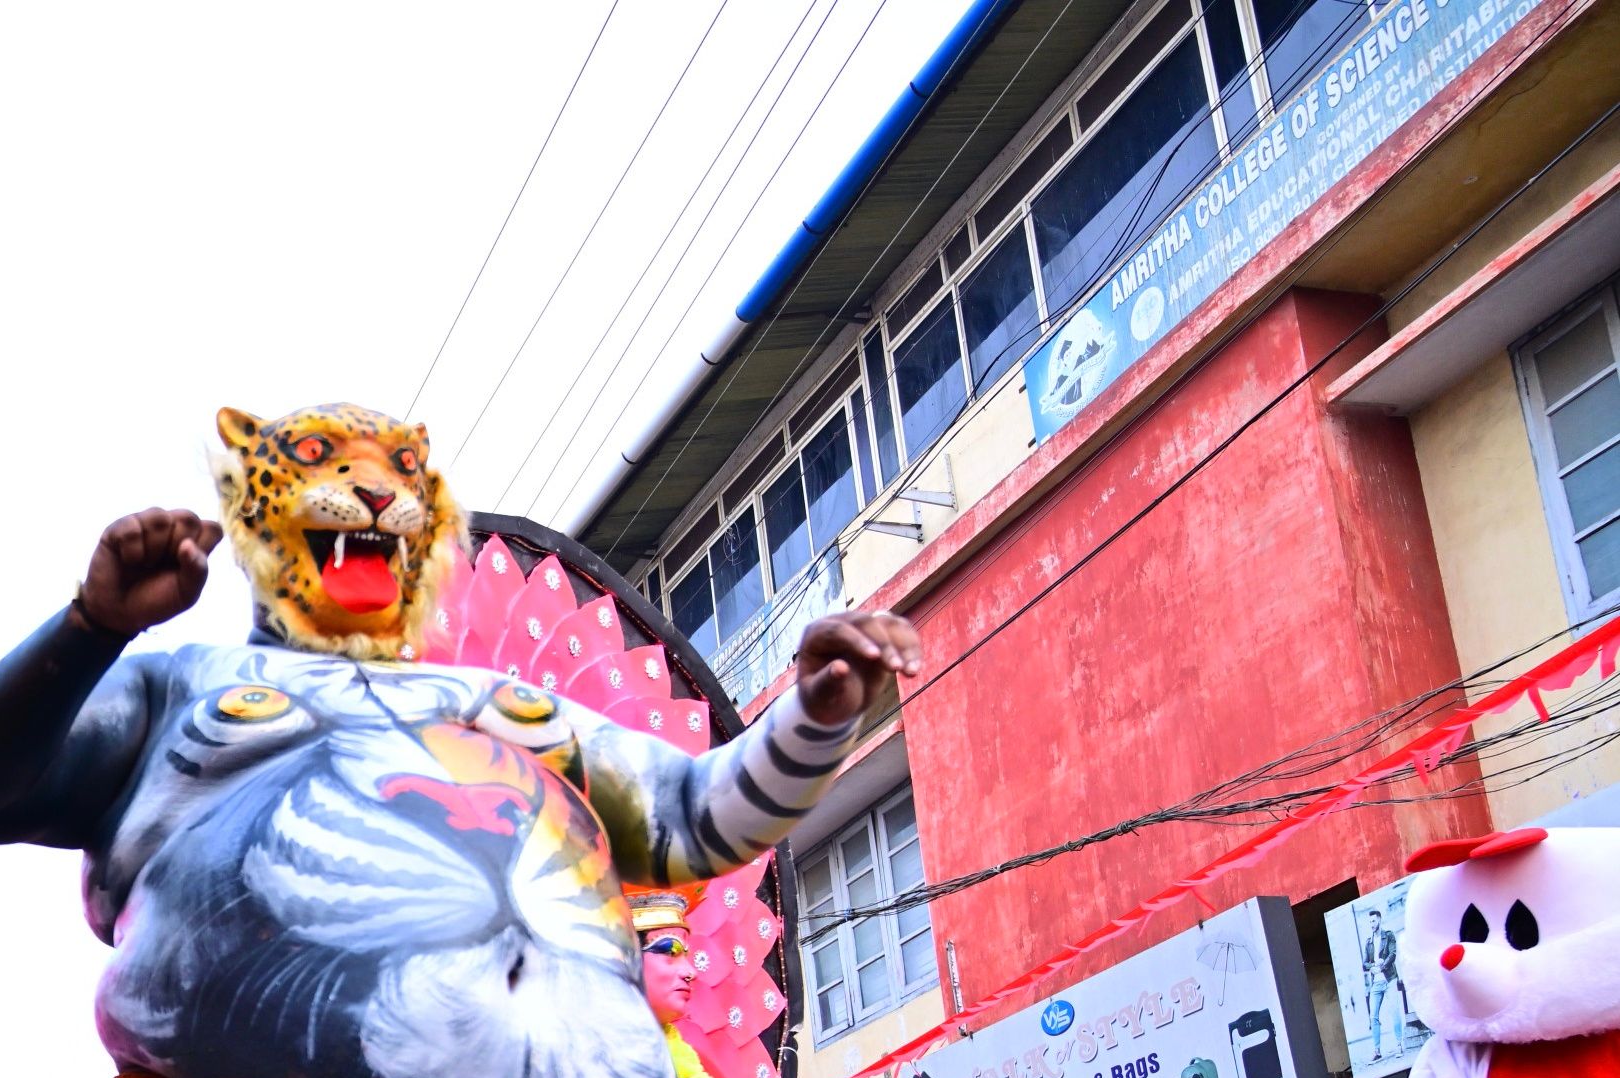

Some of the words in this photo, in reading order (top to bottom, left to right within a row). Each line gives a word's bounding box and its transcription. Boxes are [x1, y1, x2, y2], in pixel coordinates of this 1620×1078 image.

[1112, 214, 1193, 312] AMRITHA
[1195, 122, 1288, 229] COLLEGE
[1291, 91, 1322, 140] OF
[1325, 0, 1432, 109] SCIENCE
[1169, 226, 1244, 305] AMRITHA
[1247, 102, 1380, 234] EDUCATIONAL
[1227, 245, 1251, 274] ISO
[1425, 0, 1540, 97] INSTITUTIO
[1316, 78, 1382, 145] GOVERNED
[1383, 60, 1401, 85] BY
[1075, 976, 1206, 1064] STYLE
